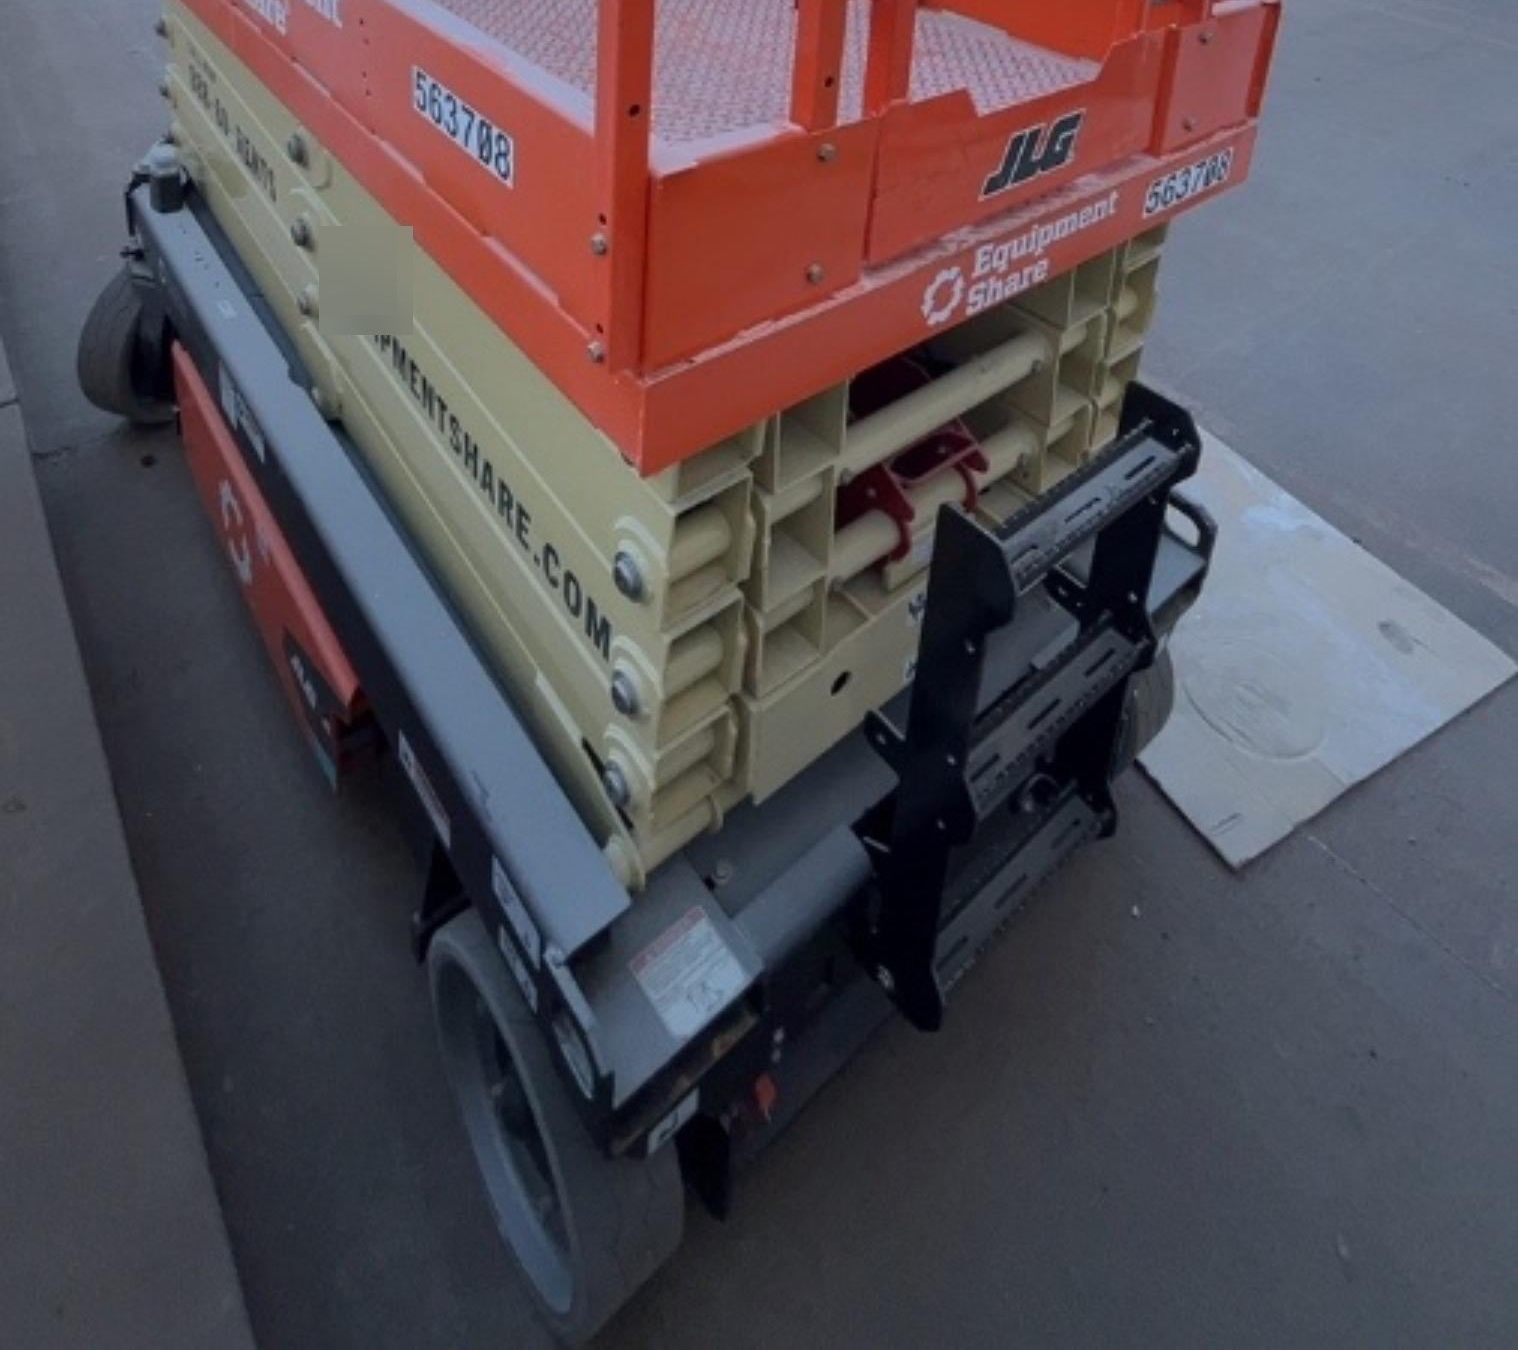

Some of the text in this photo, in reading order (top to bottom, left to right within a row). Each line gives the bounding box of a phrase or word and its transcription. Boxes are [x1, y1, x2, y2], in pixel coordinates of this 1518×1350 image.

[416, 71, 511, 180] 563708
[981, 110, 1084, 198] JLG
[1145, 150, 1231, 214] 563708
[972, 190, 1119, 279] Equipment
[966, 259, 1049, 316] Share
